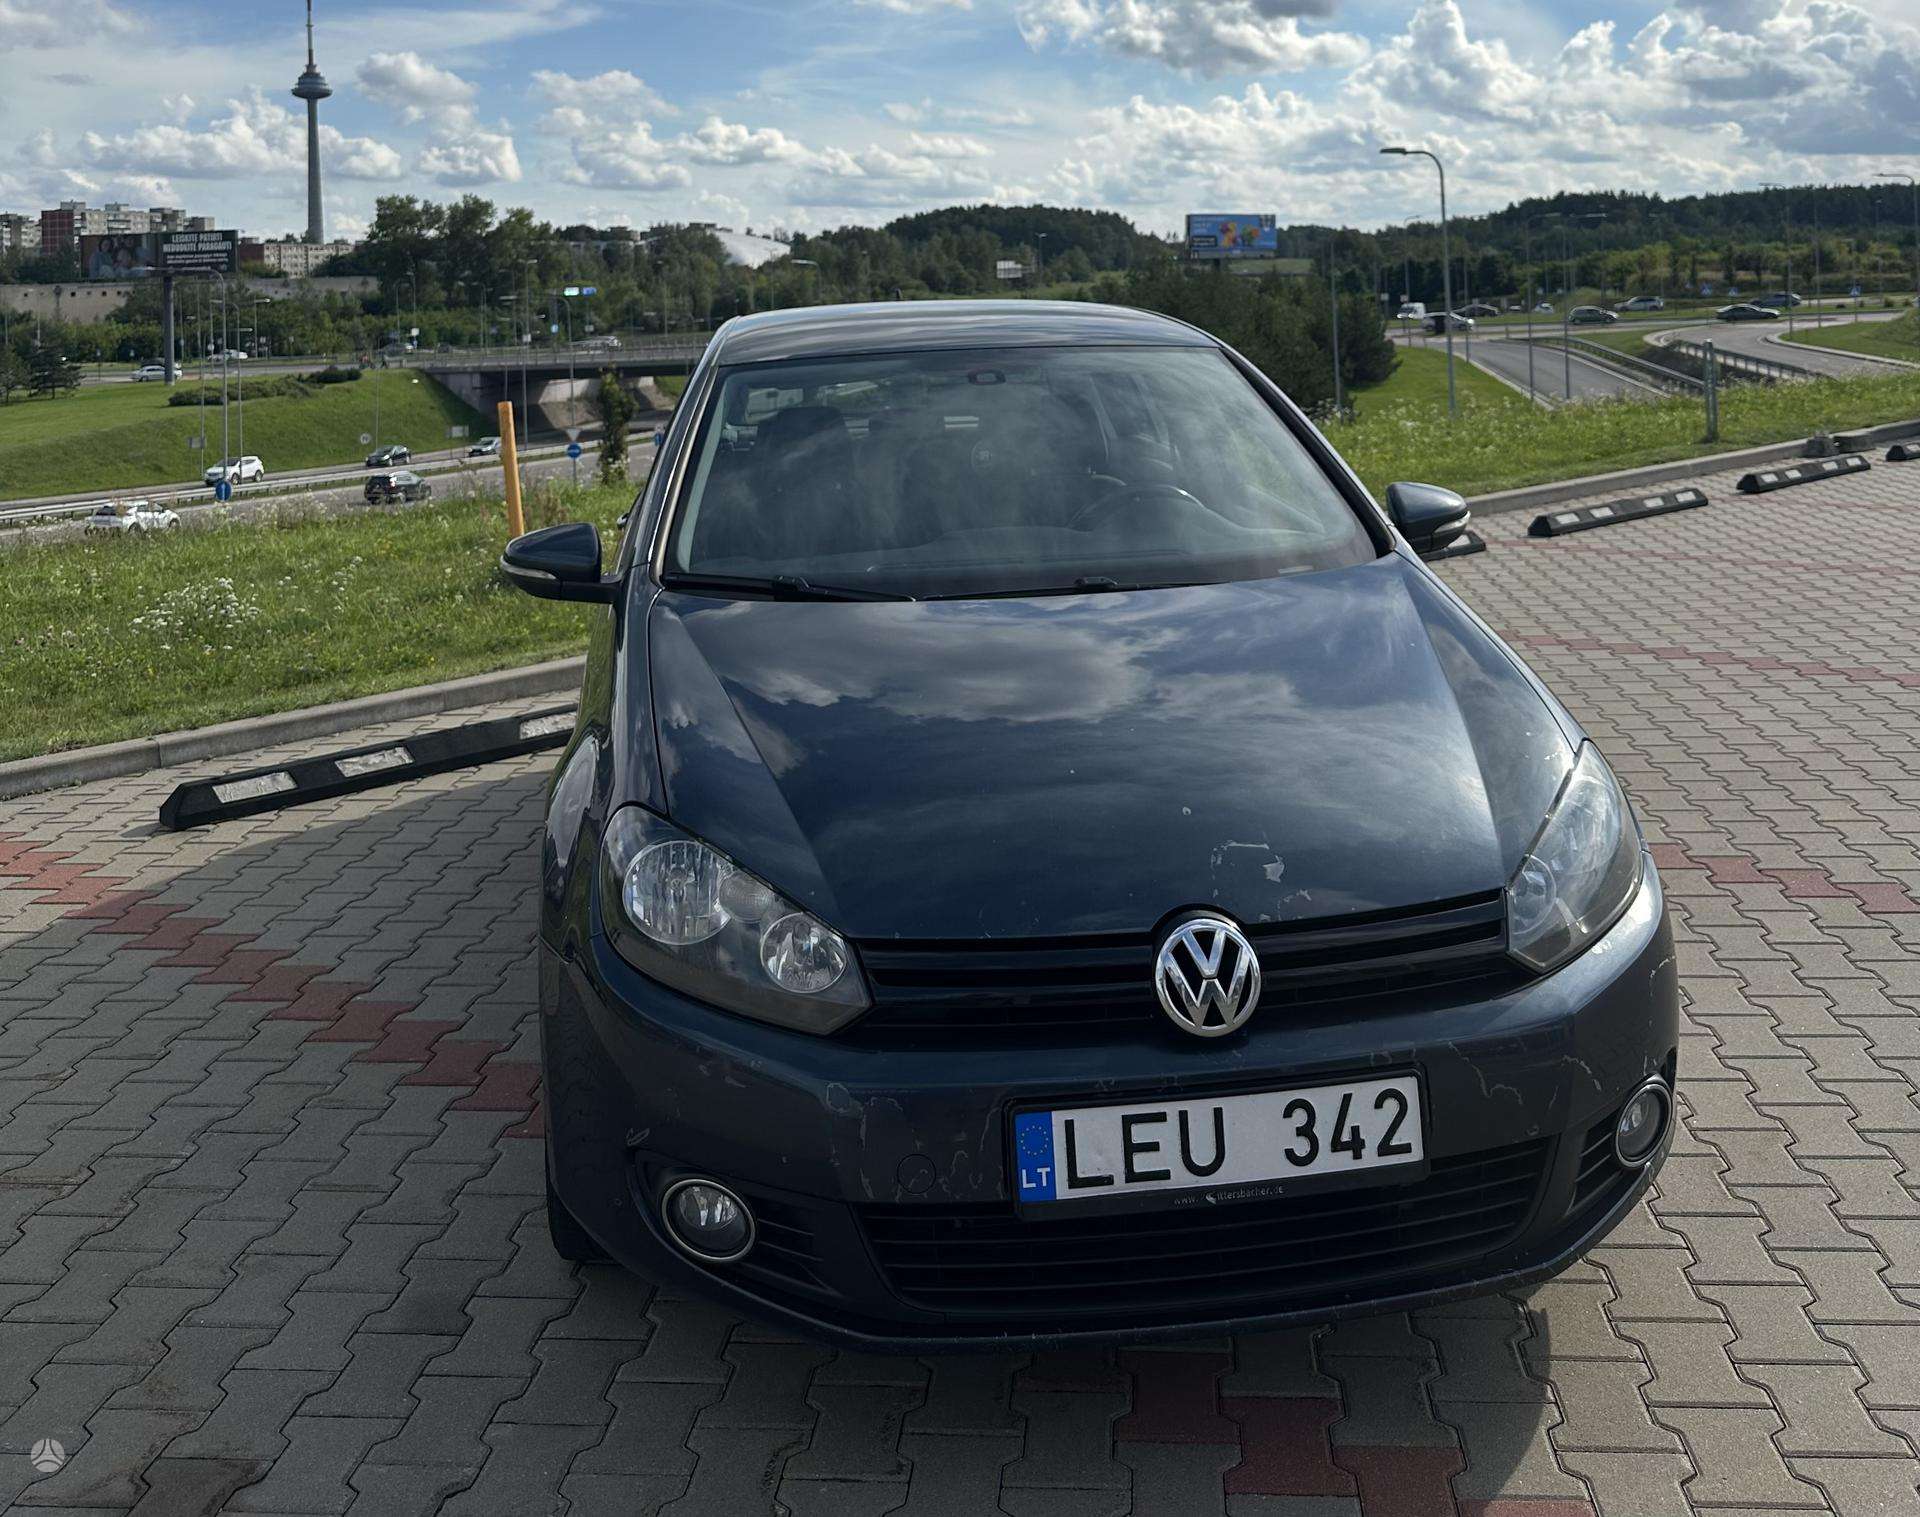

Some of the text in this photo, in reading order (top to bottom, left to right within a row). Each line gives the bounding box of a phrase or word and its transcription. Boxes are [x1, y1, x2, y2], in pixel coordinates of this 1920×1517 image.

[1155, 918, 1261, 1037] VW
[1022, 1167, 1051, 1189] LT
[1064, 1088, 1413, 1189] LEU 342
